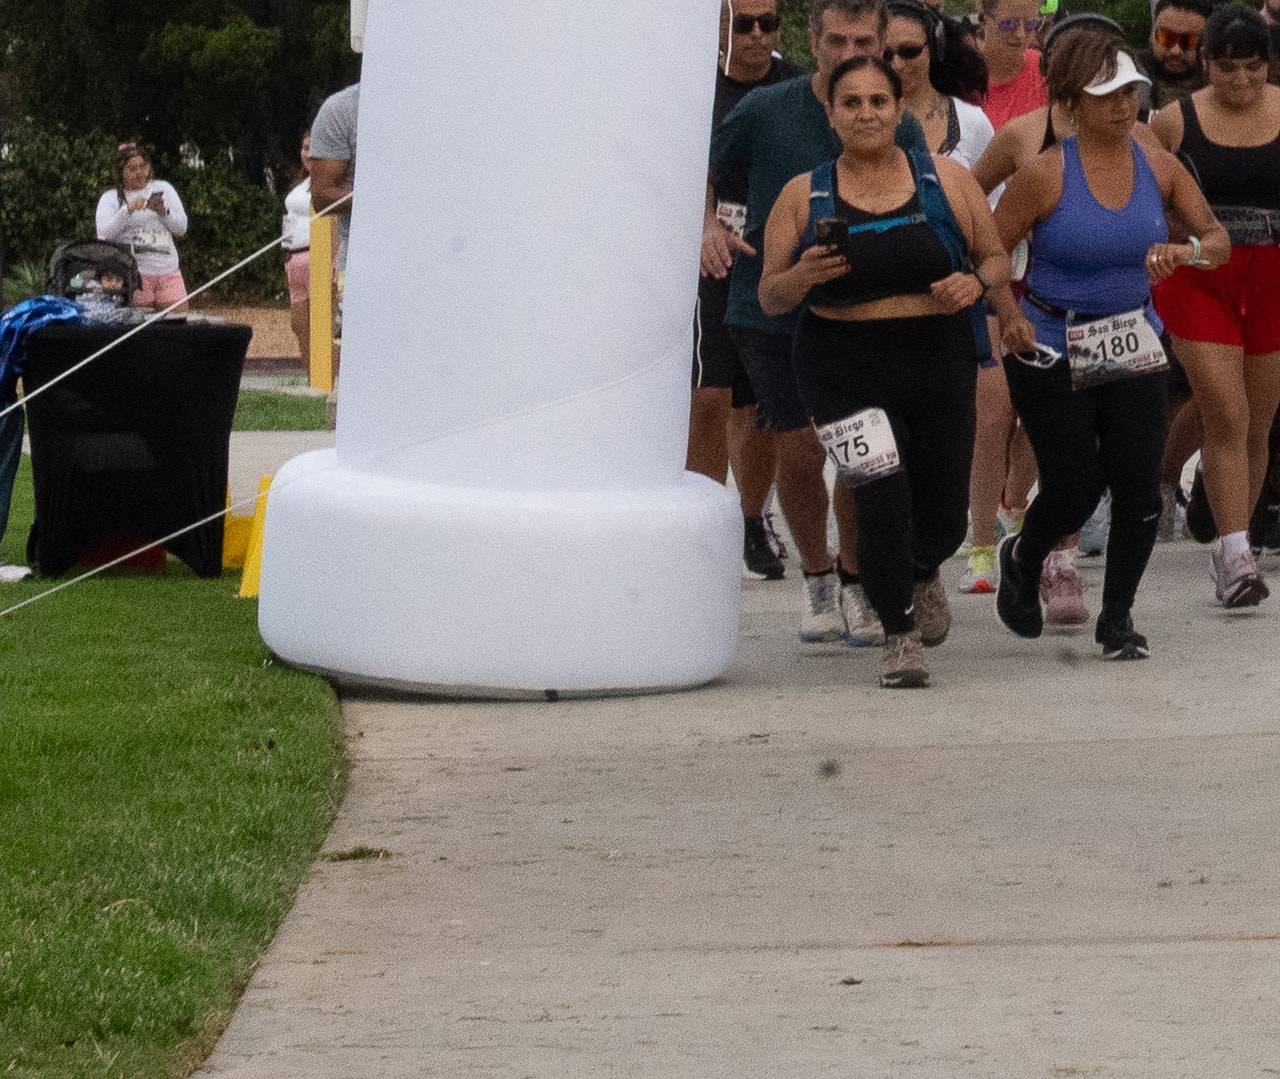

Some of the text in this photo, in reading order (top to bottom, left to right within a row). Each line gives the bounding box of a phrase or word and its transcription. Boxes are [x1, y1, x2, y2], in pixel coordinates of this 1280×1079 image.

[1087, 324, 1109, 338] San
[1111, 318, 1138, 332] Diego
[1096, 331, 1139, 361] 180
[828, 434, 869, 466] 175
